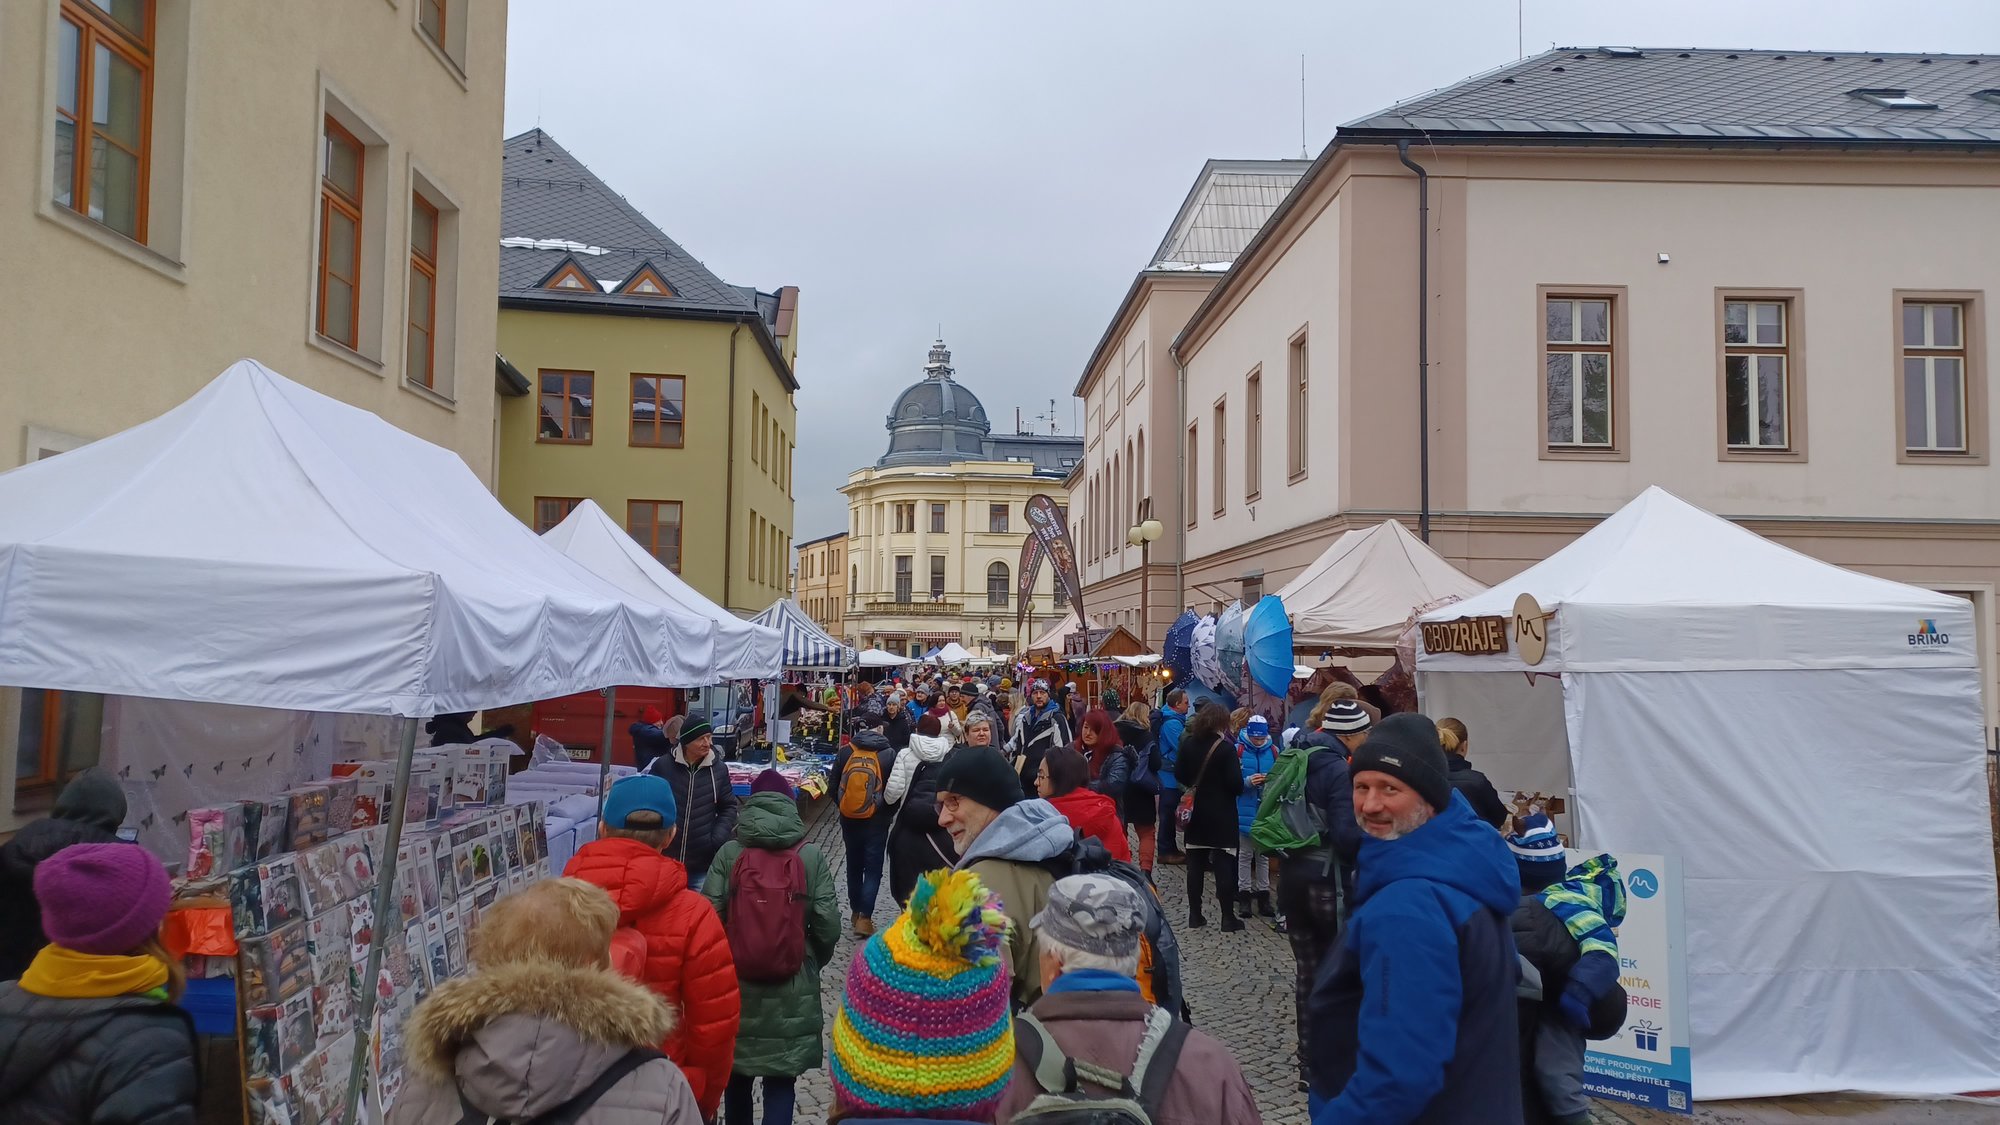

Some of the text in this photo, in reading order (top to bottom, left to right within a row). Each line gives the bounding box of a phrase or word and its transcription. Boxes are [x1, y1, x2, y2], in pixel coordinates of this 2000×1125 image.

[1424, 617, 1500, 652] CBDZRÁJE
[1908, 633, 1949, 645] BRIMO
[1621, 957, 1638, 969] EK
[1621, 976, 1650, 990] NITA
[1627, 994, 1662, 1009] ERGIE
[1584, 1055, 1652, 1073] OPNÉ PRODUKTY
[1583, 1064, 1671, 1088] ONÁLNÍHO PĚSTITELE
[1583, 1084, 1650, 1102] w.cbdzraje.cz
